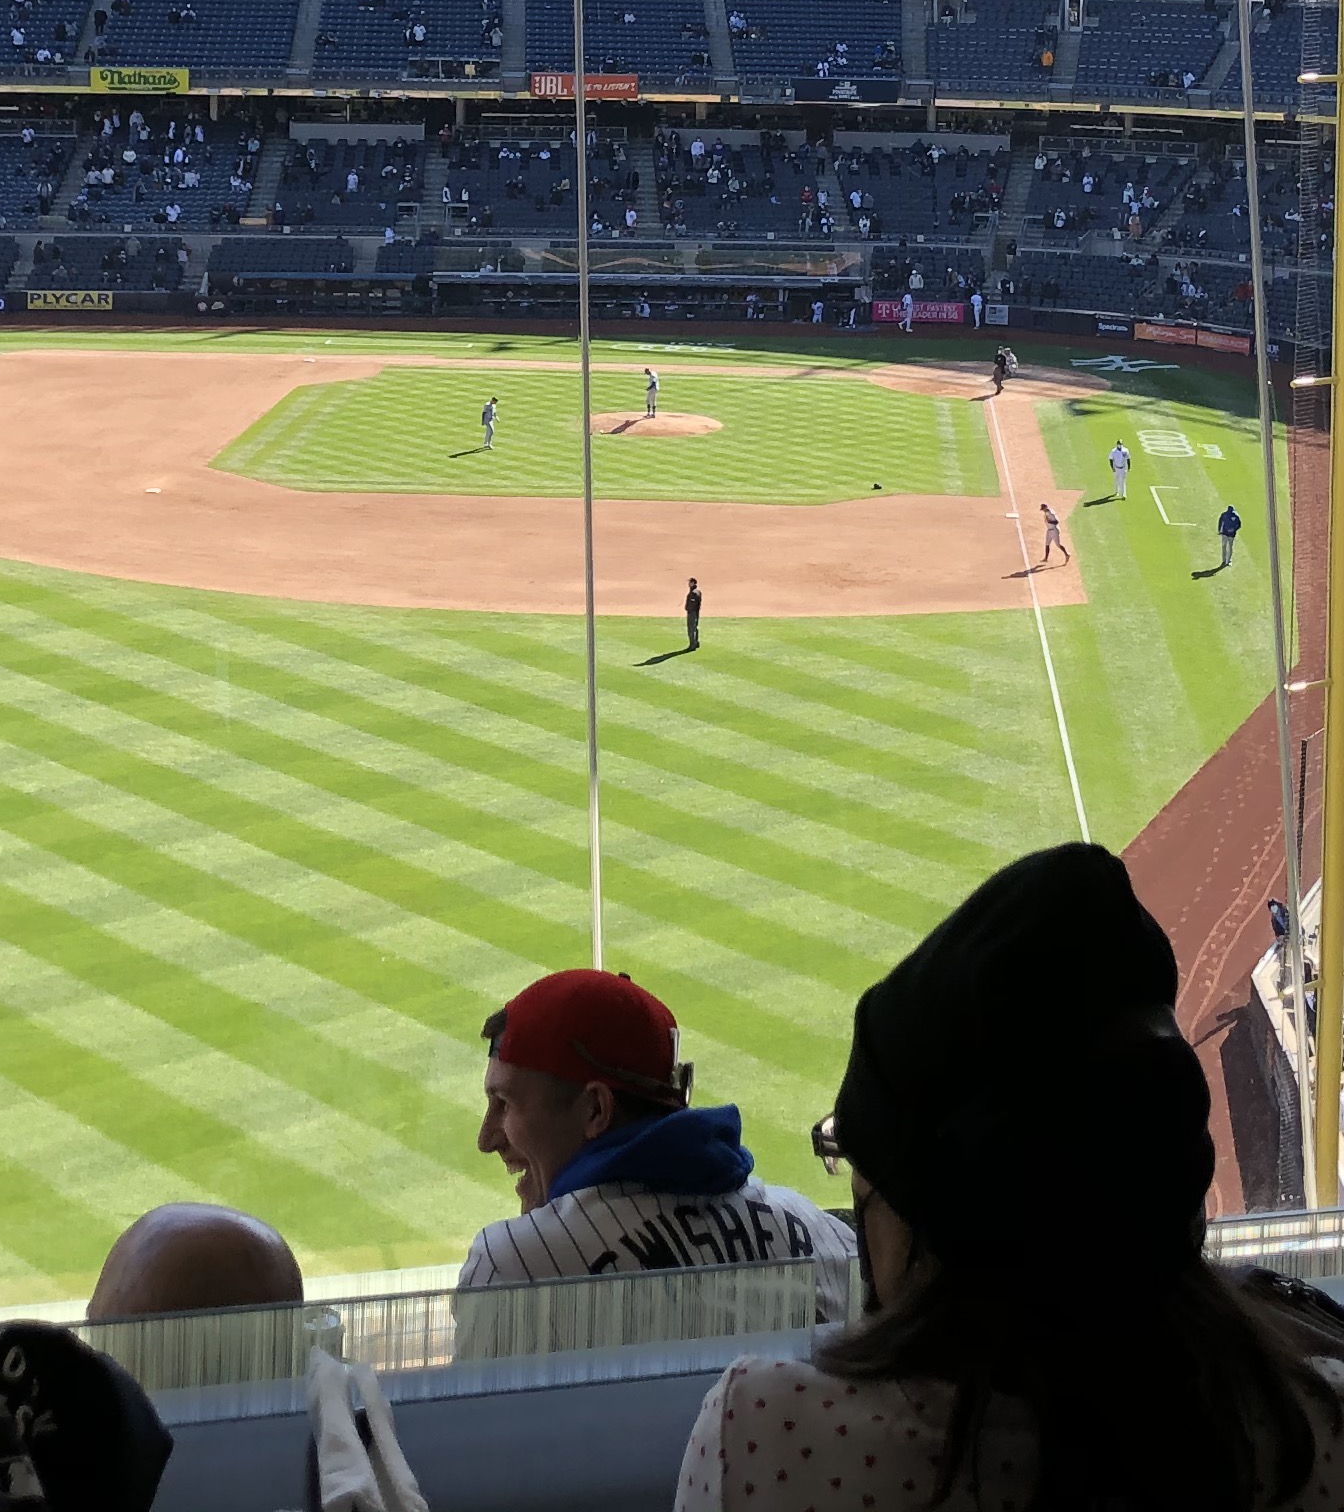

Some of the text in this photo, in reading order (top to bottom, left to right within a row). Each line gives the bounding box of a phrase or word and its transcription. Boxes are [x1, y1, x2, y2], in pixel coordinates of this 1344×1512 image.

[100, 69, 178, 87] Nathan's
[536, 75, 567, 96] JBL
[29, 292, 110, 305] PLYCAR
